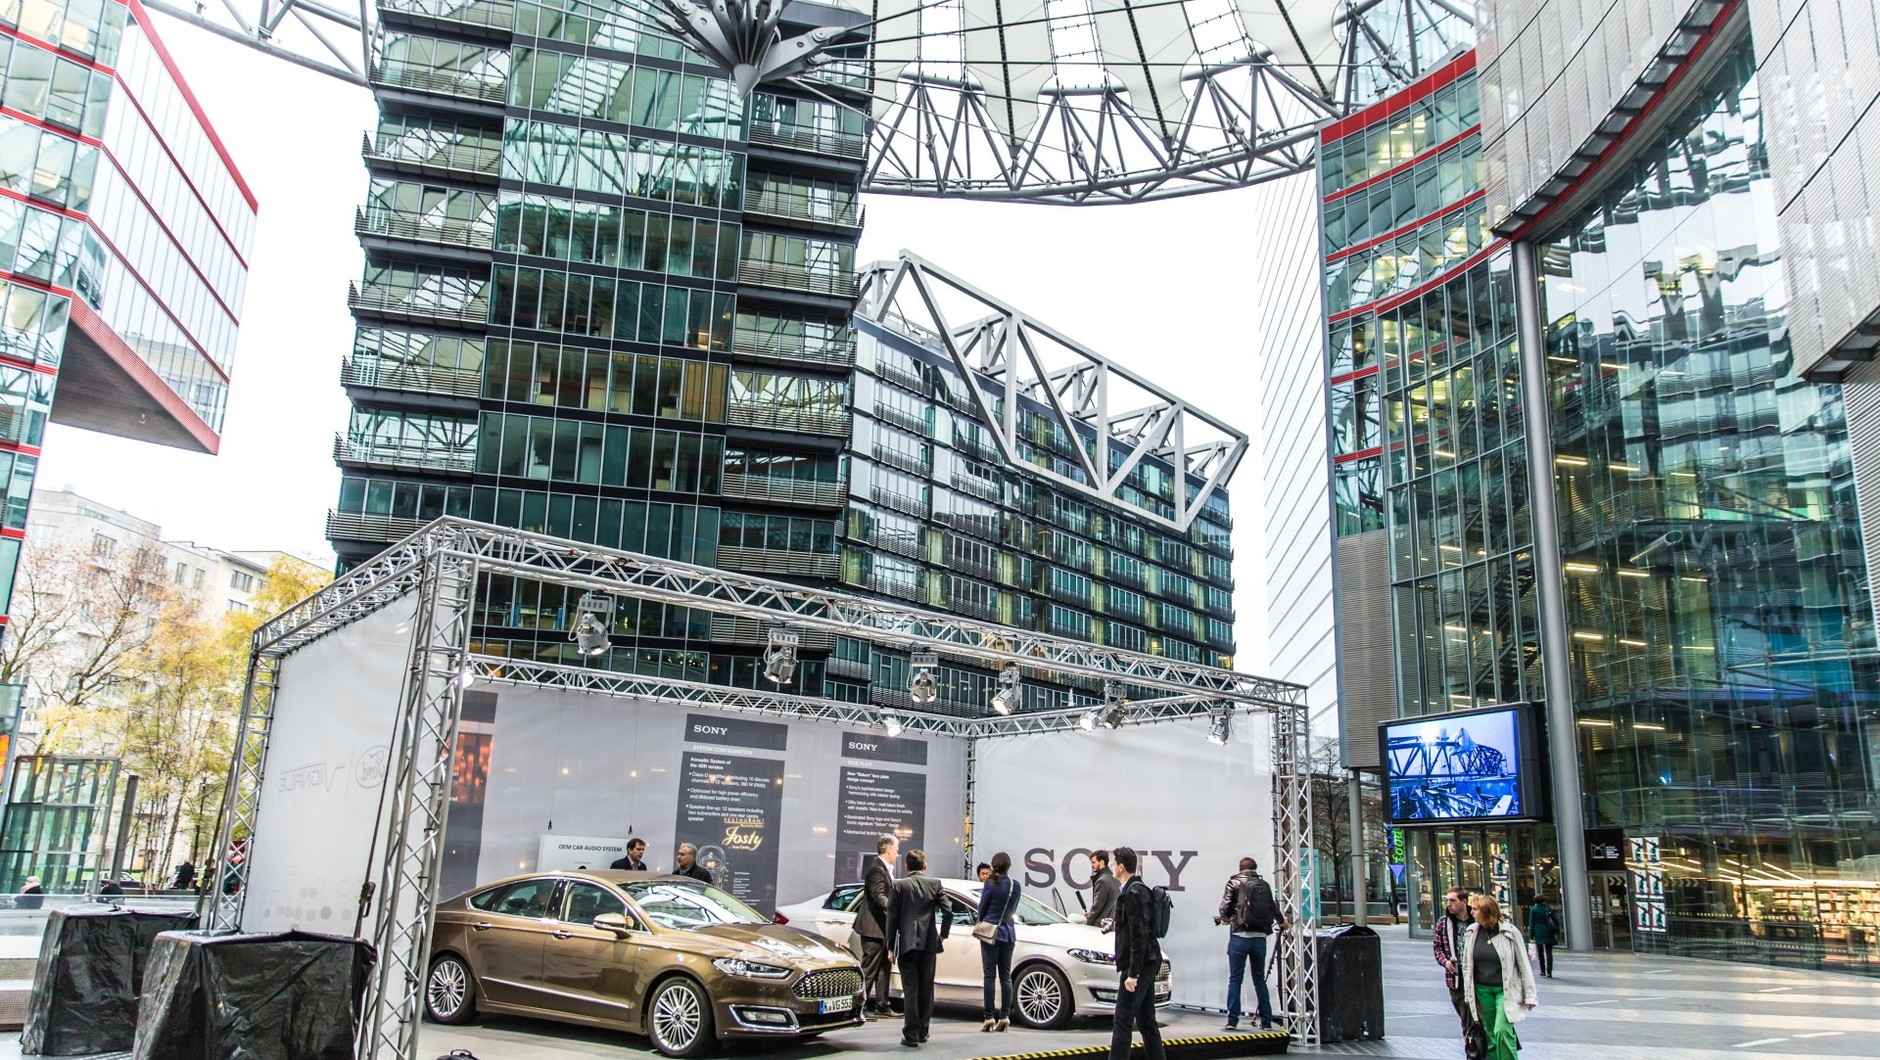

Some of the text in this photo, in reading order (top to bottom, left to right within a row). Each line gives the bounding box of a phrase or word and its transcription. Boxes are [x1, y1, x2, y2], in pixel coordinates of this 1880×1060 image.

[694, 724, 728, 735] SONY
[848, 742, 878, 751] SONY
[722, 826, 763, 851] Josty
[1392, 828, 1405, 862] food
[1024, 848, 1198, 891] SOY
